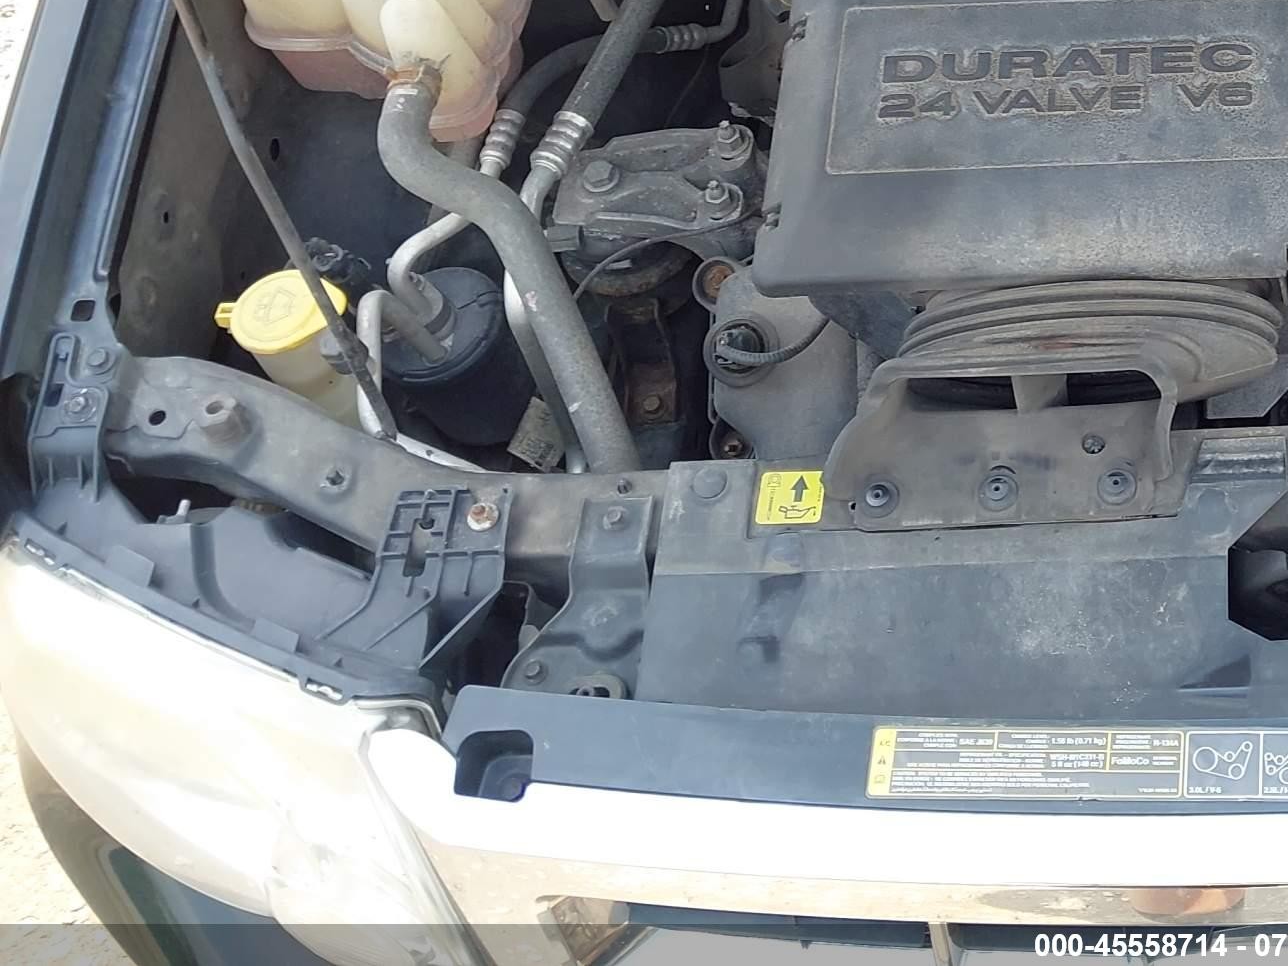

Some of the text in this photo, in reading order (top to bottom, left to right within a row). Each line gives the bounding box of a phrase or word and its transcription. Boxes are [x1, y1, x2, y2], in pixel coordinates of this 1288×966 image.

[881, 43, 1254, 84] DURATEC
[877, 81, 1254, 120] 24 VALVE V6
[1111, 756, 1149, 766] FoMoCo
